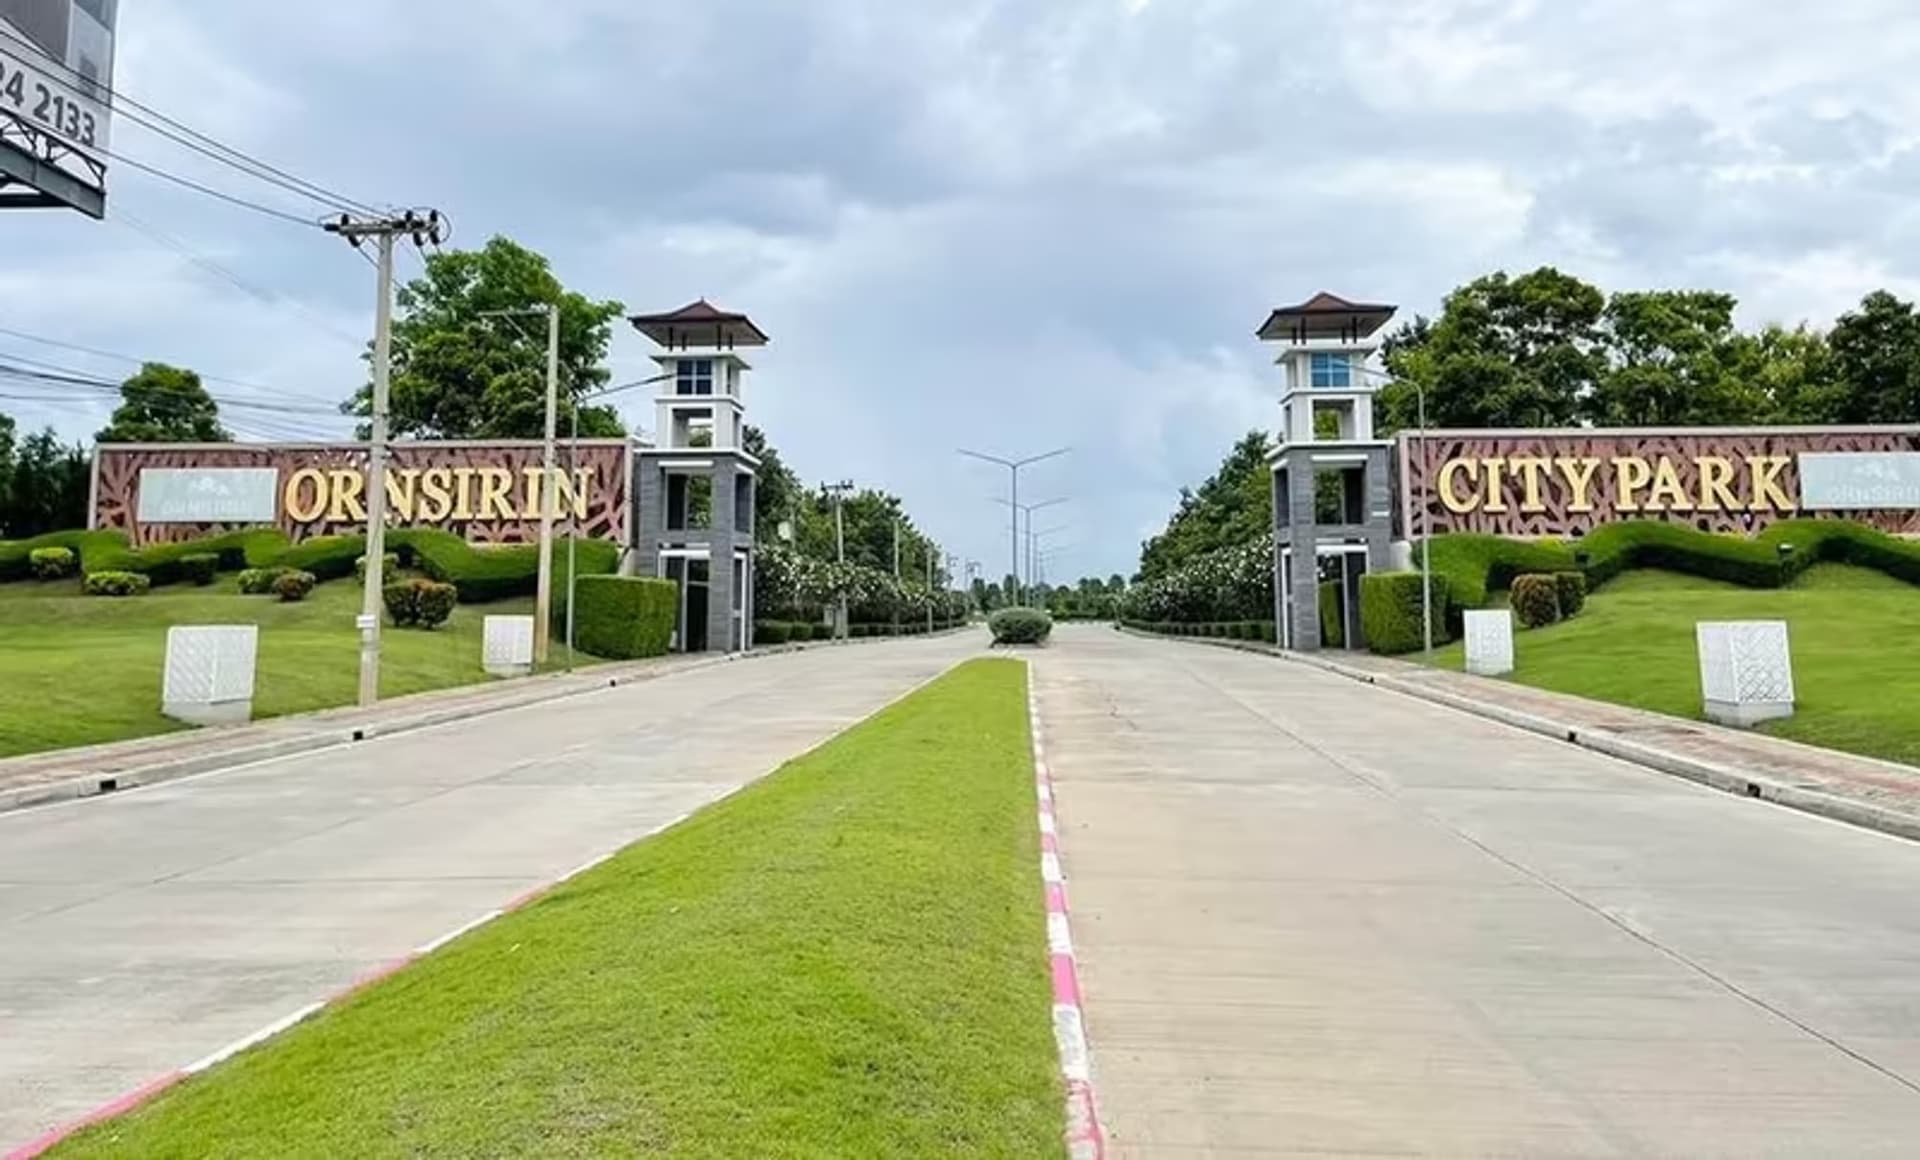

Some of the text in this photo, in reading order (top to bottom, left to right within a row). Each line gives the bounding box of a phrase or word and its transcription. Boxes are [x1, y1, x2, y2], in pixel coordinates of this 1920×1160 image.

[0, 62, 96, 148] 4 2133
[286, 467, 595, 523] ORNSIRIN
[1438, 456, 1795, 513] CITY PARK
